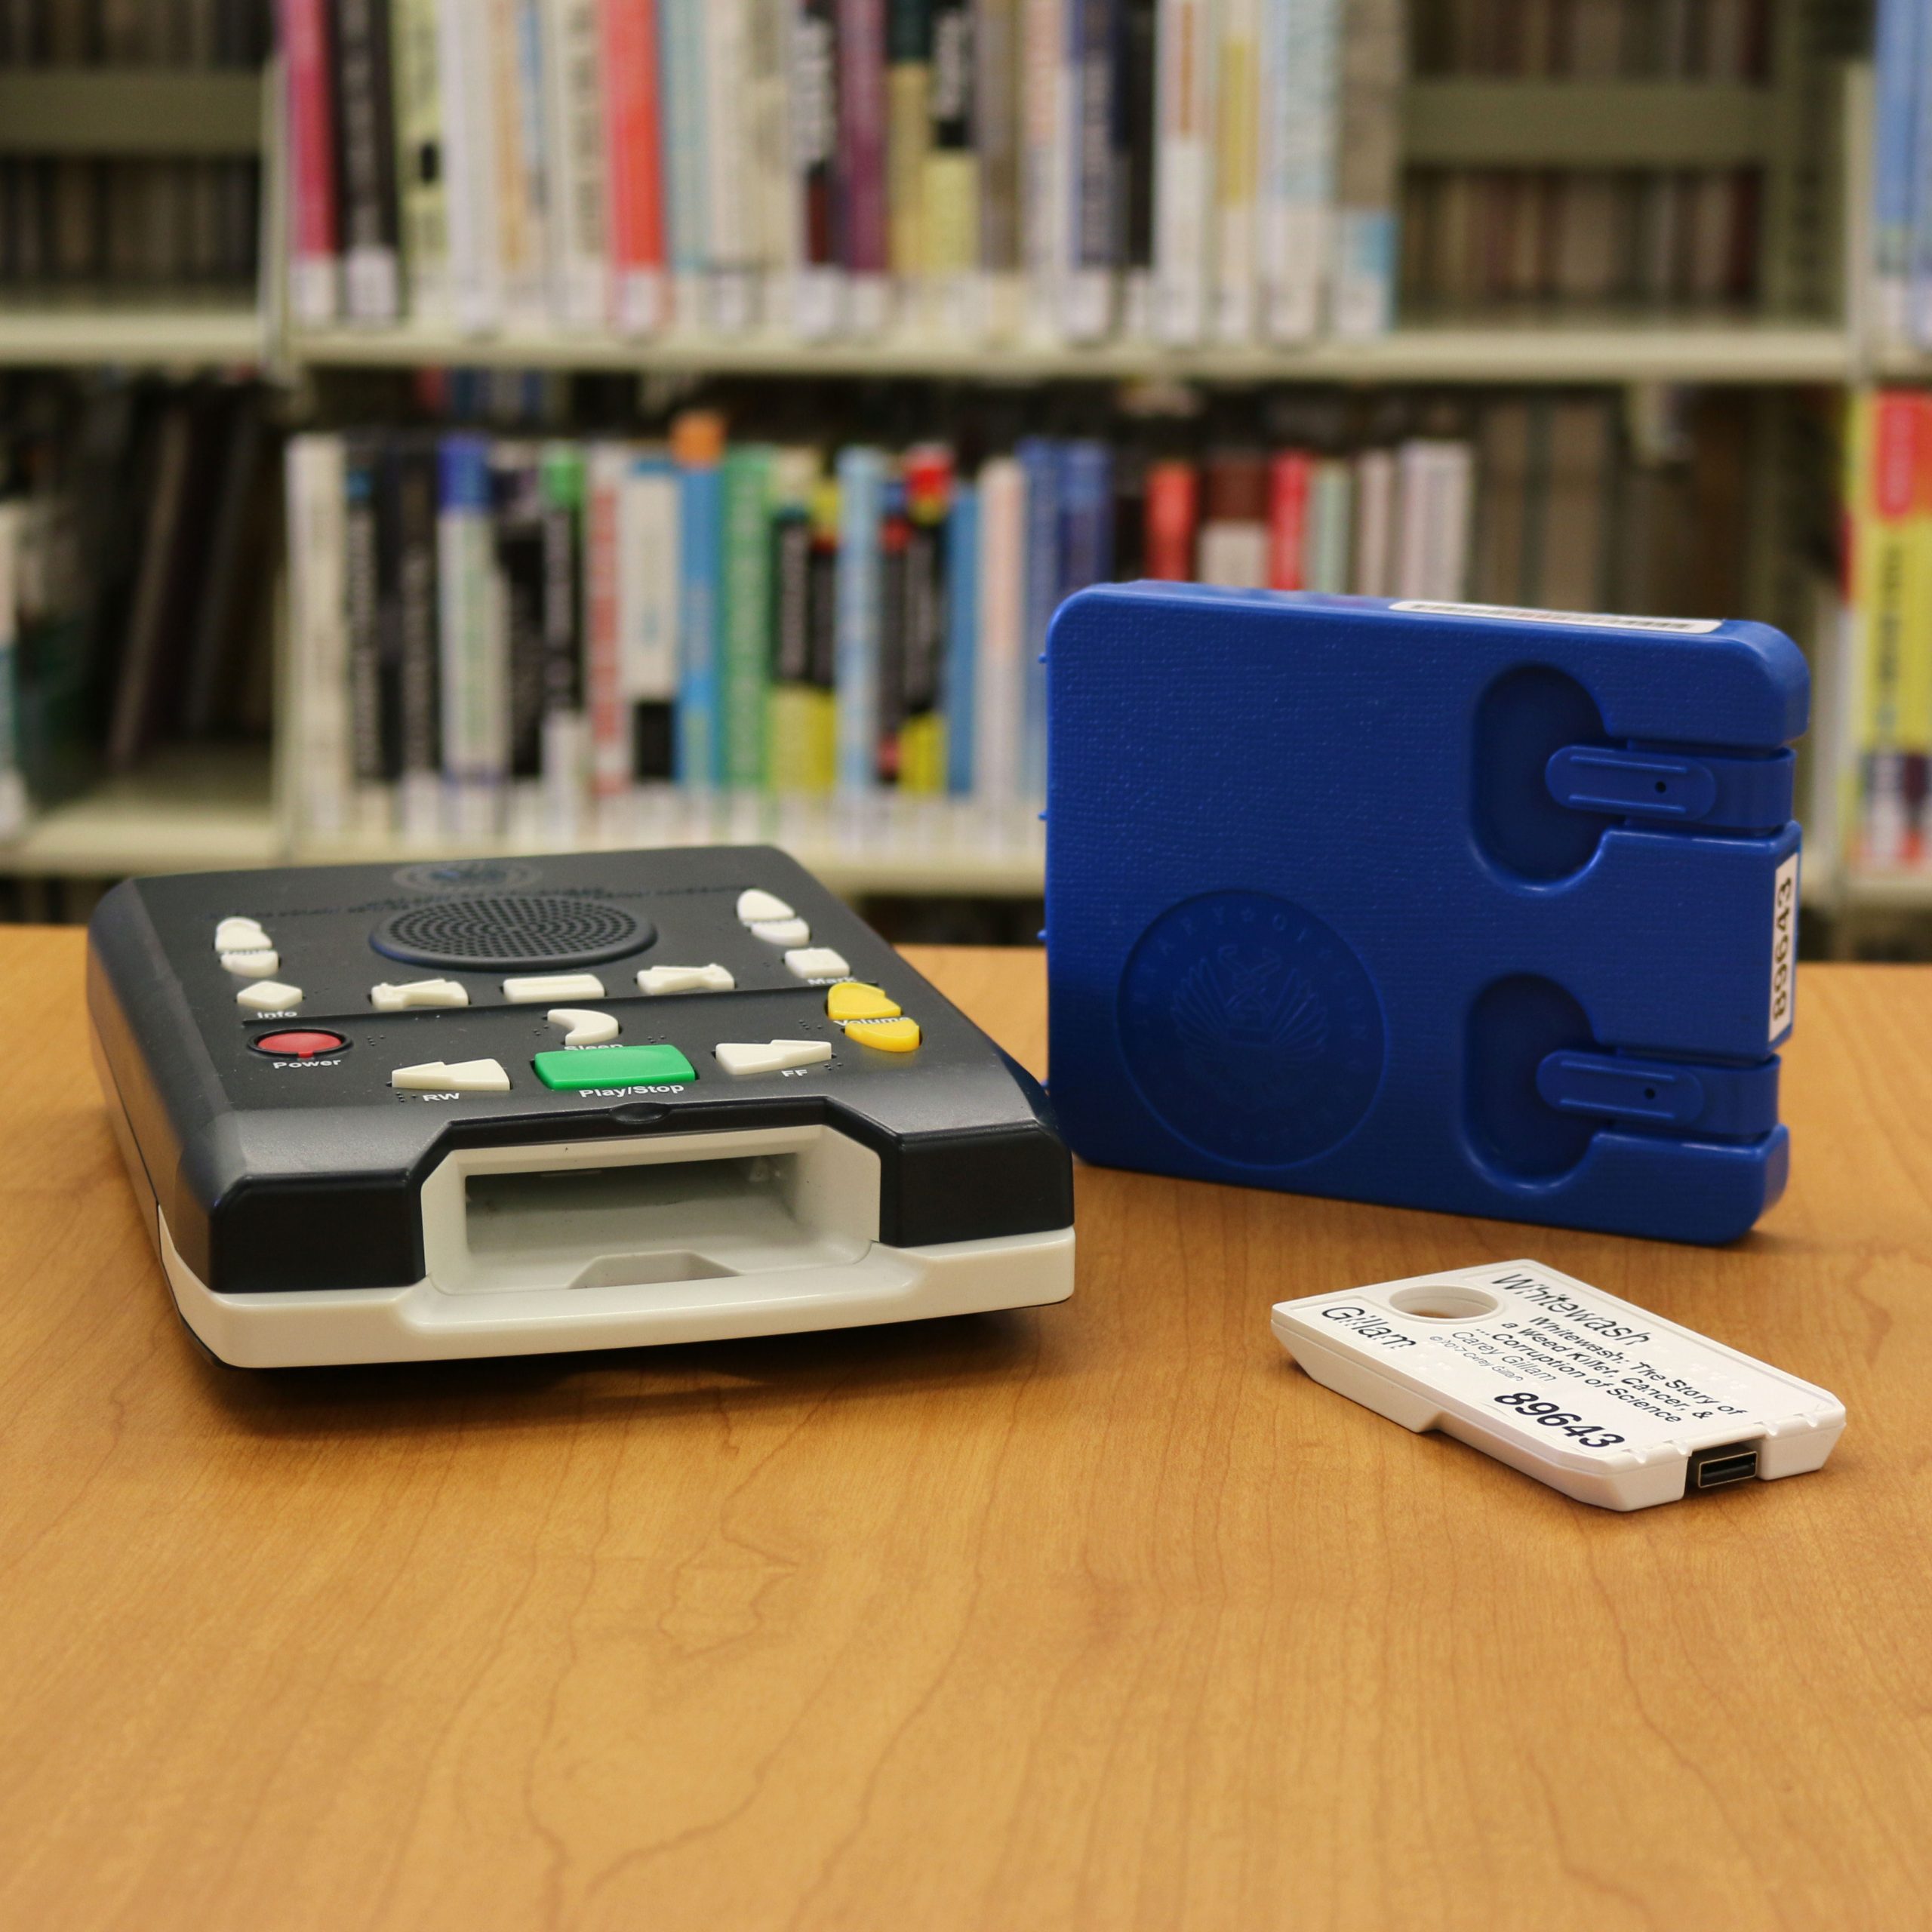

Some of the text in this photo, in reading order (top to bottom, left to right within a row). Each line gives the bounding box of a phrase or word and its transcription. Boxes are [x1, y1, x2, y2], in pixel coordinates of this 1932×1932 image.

[1774, 876, 1792, 1021] 89643
[272, 1060, 341, 1069] Power
[422, 1092, 460, 1102] RW
[579, 1084, 685, 1098] Play/Stop
[1321, 1306, 1417, 1349] Gillam
[1491, 1273, 1651, 1346] Whitewash
[1452, 1331, 1557, 1382] Carey Gillam
[1463, 1352, 1493, 1367] Carey
[1491, 1366, 1524, 1381] Gillam
[1517, 1327, 1573, 1352] Weed
[1621, 1377, 1690, 1411] Cancer,
[1692, 1411, 1713, 1419] &
[1584, 1378, 1614, 1388] of
[1606, 1388, 1681, 1423] Science
[1629, 1361, 1666, 1381] The
[1665, 1379, 1720, 1404] Story
[1717, 1404, 1747, 1415] of
[1494, 1392, 1625, 1447] 89643
